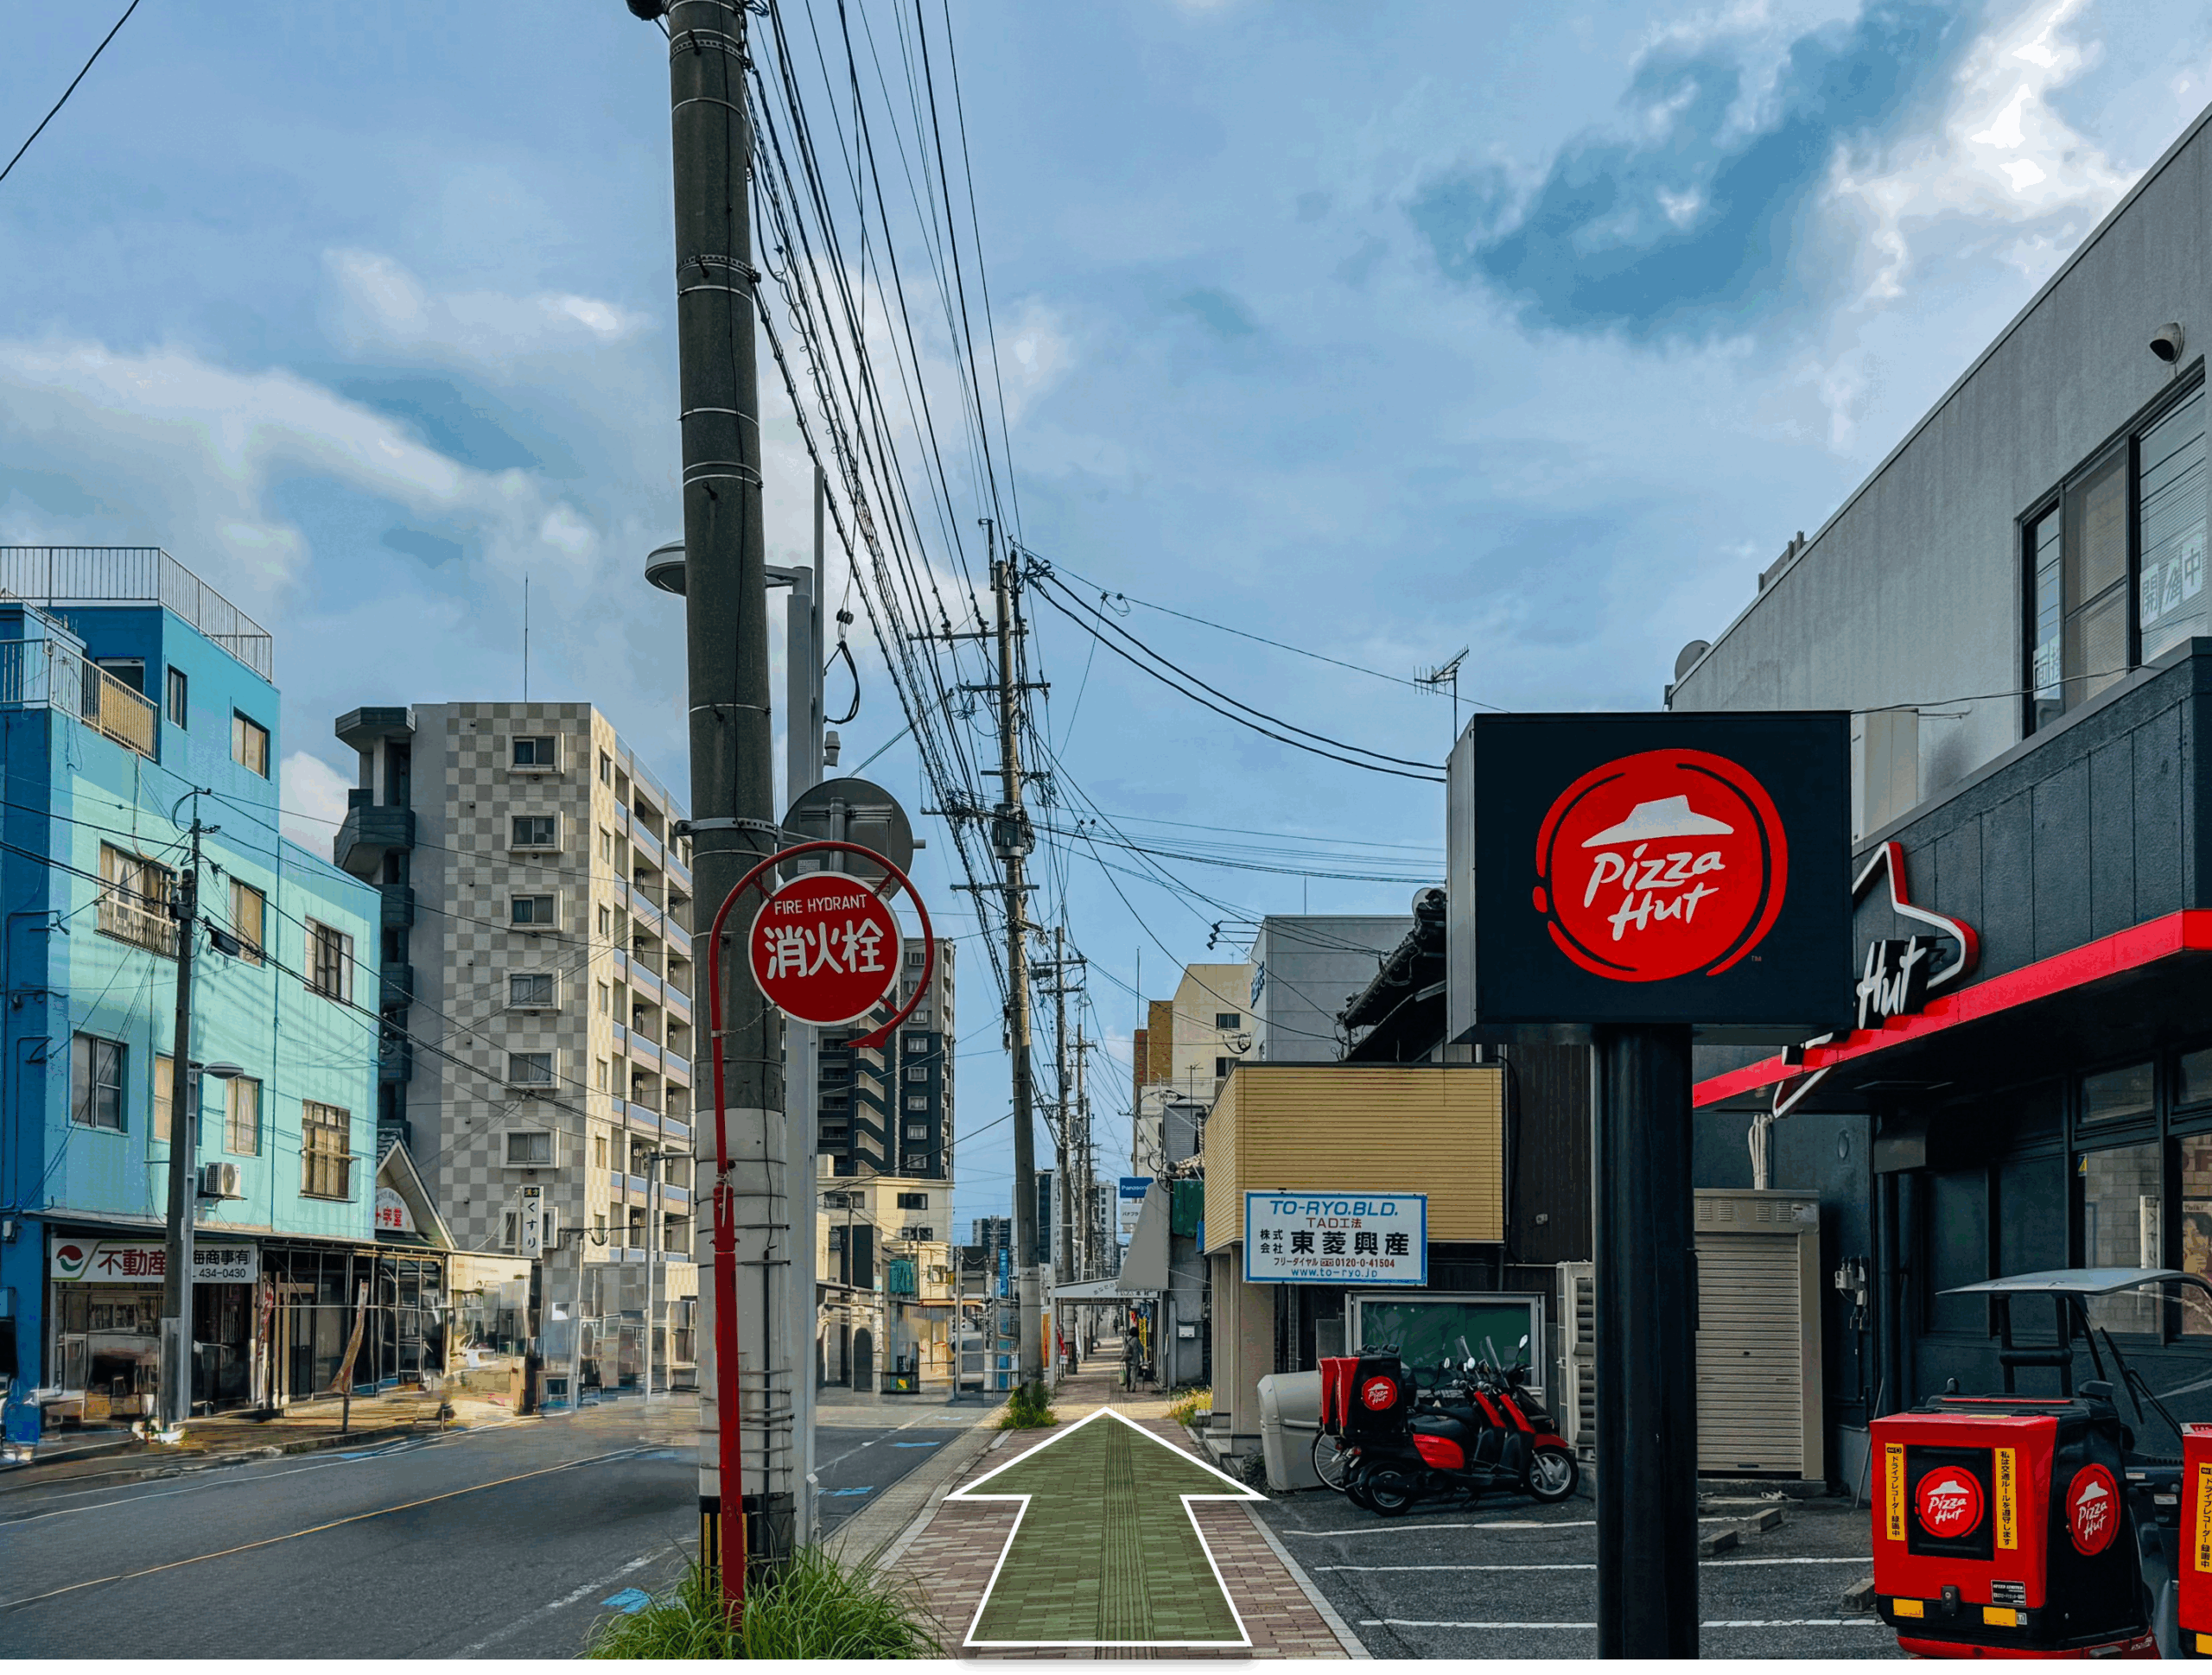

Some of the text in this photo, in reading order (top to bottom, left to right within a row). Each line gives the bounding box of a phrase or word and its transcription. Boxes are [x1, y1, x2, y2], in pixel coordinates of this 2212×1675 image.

[1584, 842, 1726, 908] Pizza
[774, 893, 868, 916] FIRE HYDRANT
[1607, 882, 1719, 942] Hut
[763, 917, 886, 980] 消火栓
[1856, 935, 1927, 1031] Hut
[1270, 1201, 1398, 1215] TO-RYO.BLD.
[525, 1202, 537, 1249] くすり
[1306, 1217, 1363, 1229] TAD工法
[1260, 1228, 1284, 1240] 株式
[1290, 1229, 1409, 1256] 東菱興産
[1260, 1242, 1283, 1254] 会社
[199, 1267, 246, 1278] 434-0430
[1274, 1257, 1395, 1268] フリーダイヤル 0120-0-41504
[1291, 1267, 1378, 1278] www.to-ryo.jp
[1927, 1494, 1967, 1513] Pizza
[1935, 1507, 1966, 1525] Hut
[2077, 1501, 2108, 1530] Pizza
[2083, 1513, 2107, 1541] Hut
